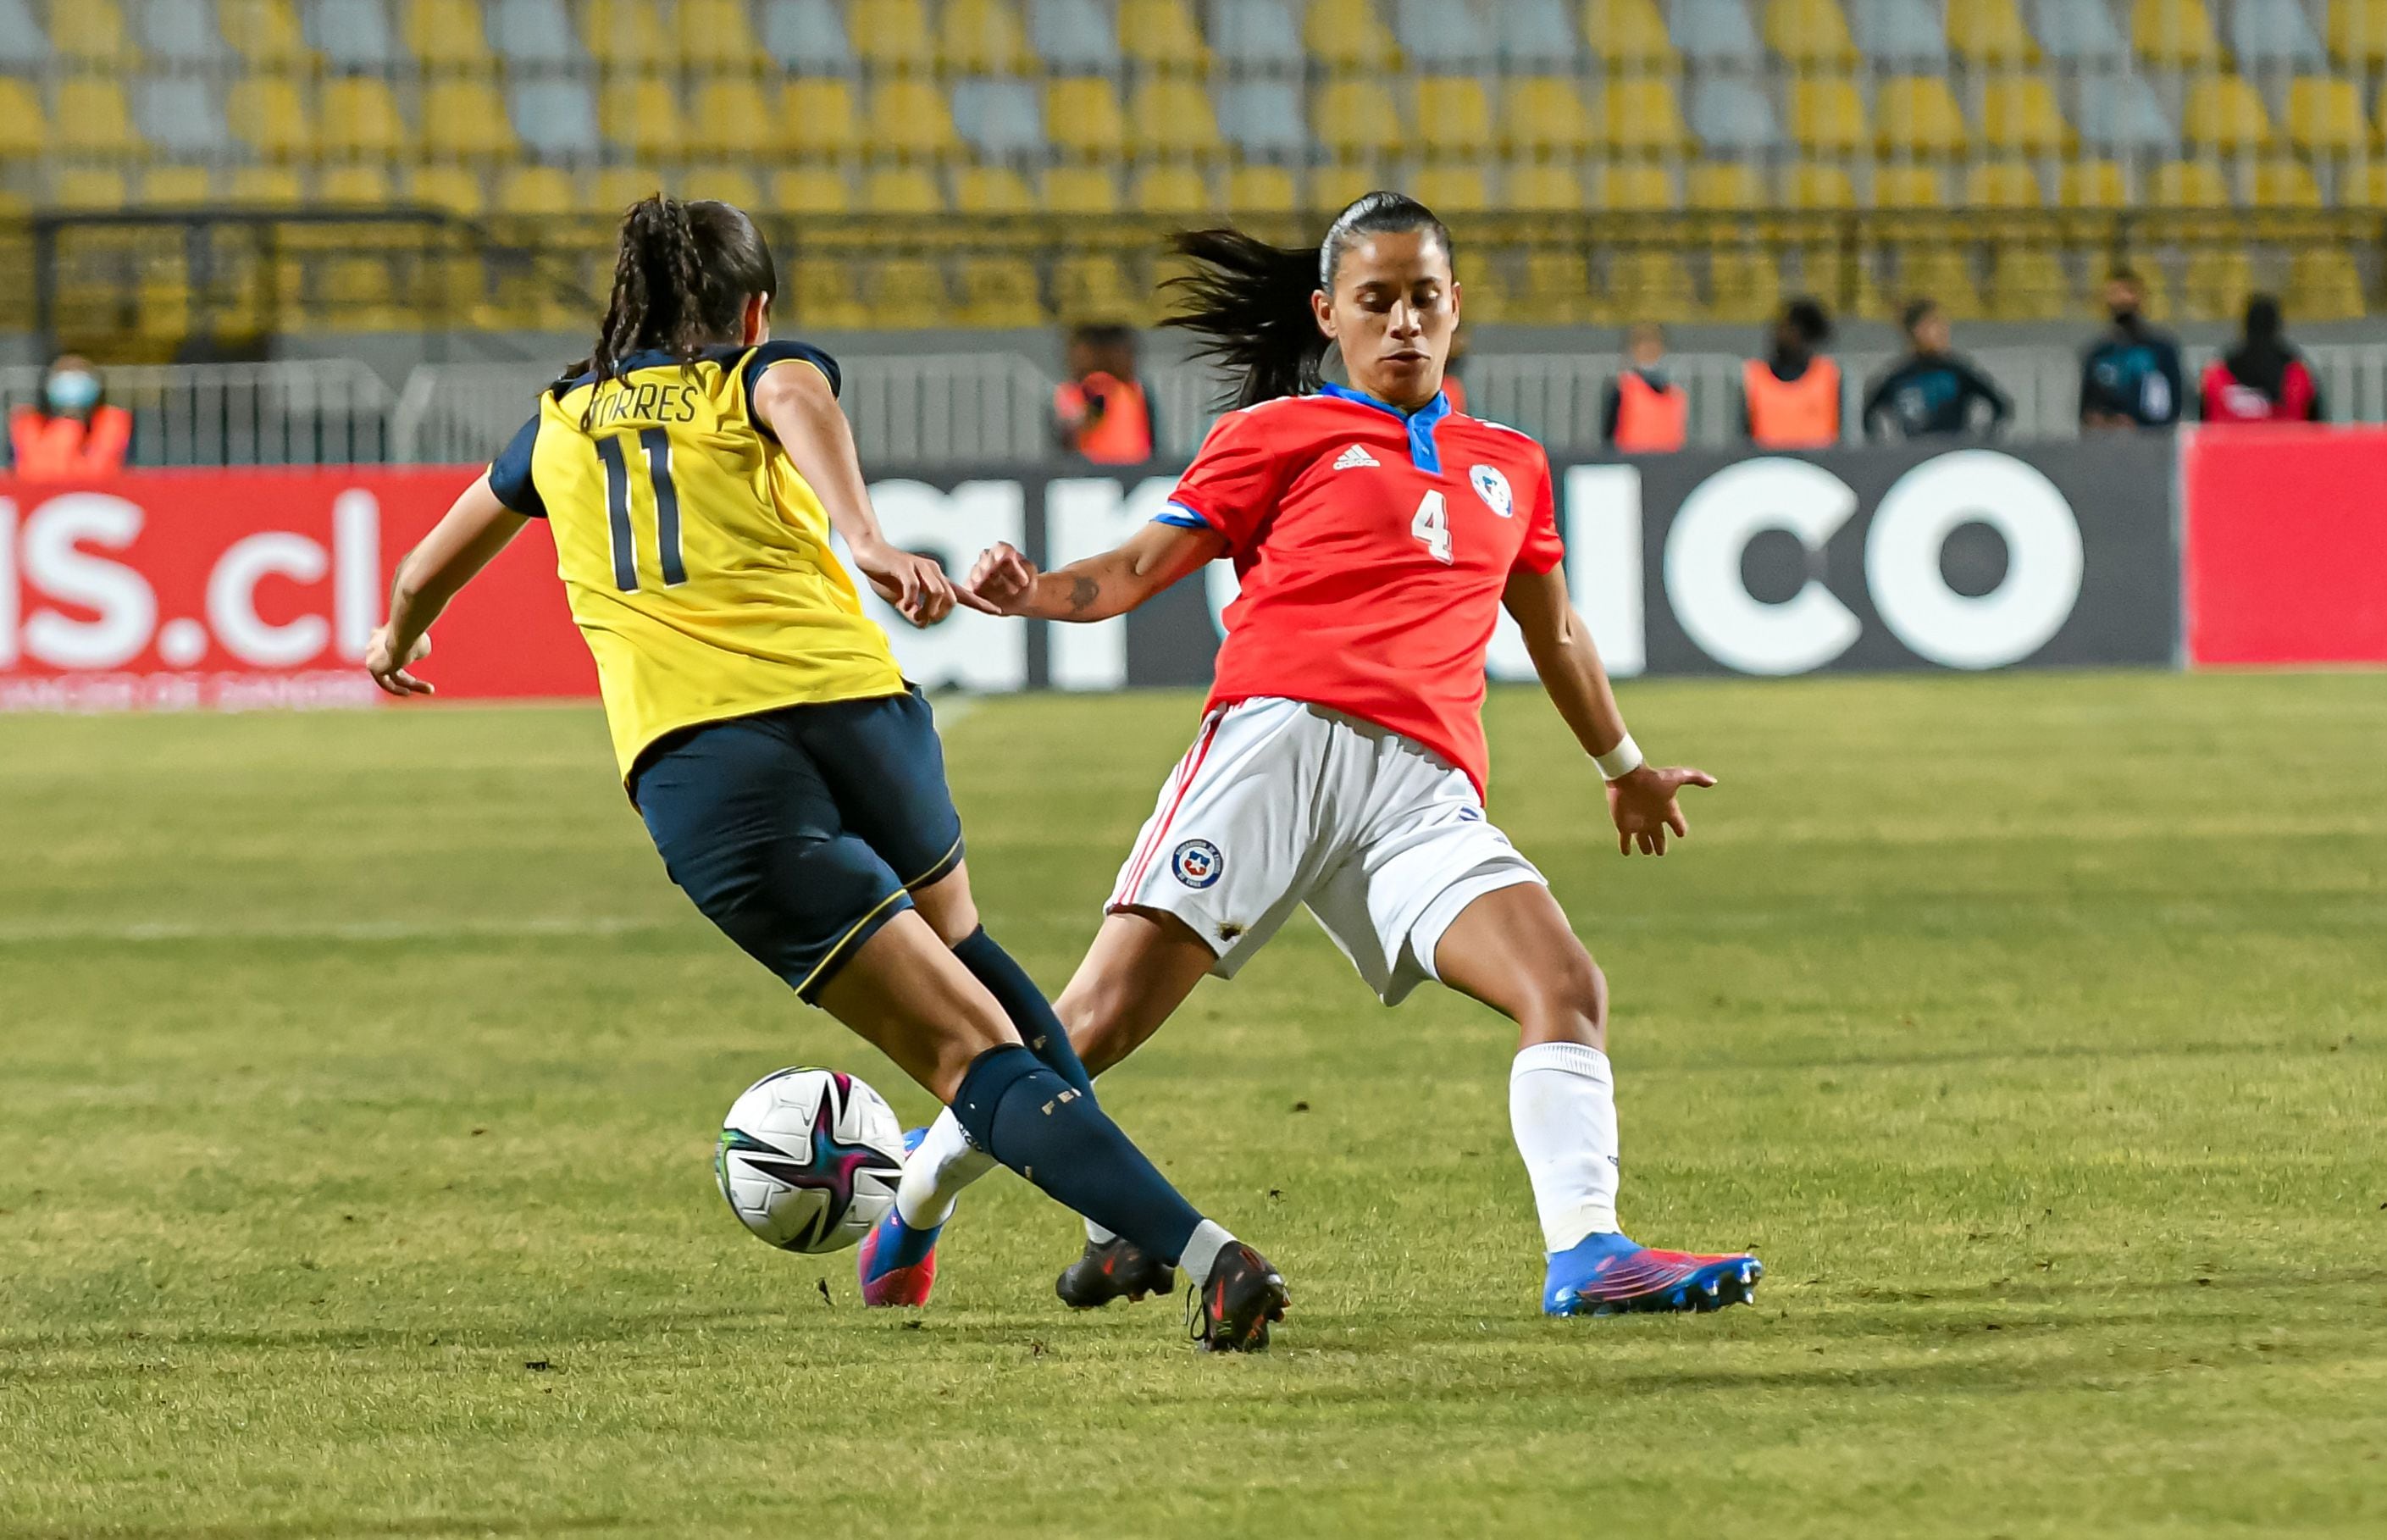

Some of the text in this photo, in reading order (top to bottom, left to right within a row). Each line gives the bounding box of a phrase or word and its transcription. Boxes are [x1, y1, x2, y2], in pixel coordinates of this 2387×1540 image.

[0, 487, 381, 669] S.cl
[595, 425, 690, 595] 11
[1411, 489, 1454, 566] 4
